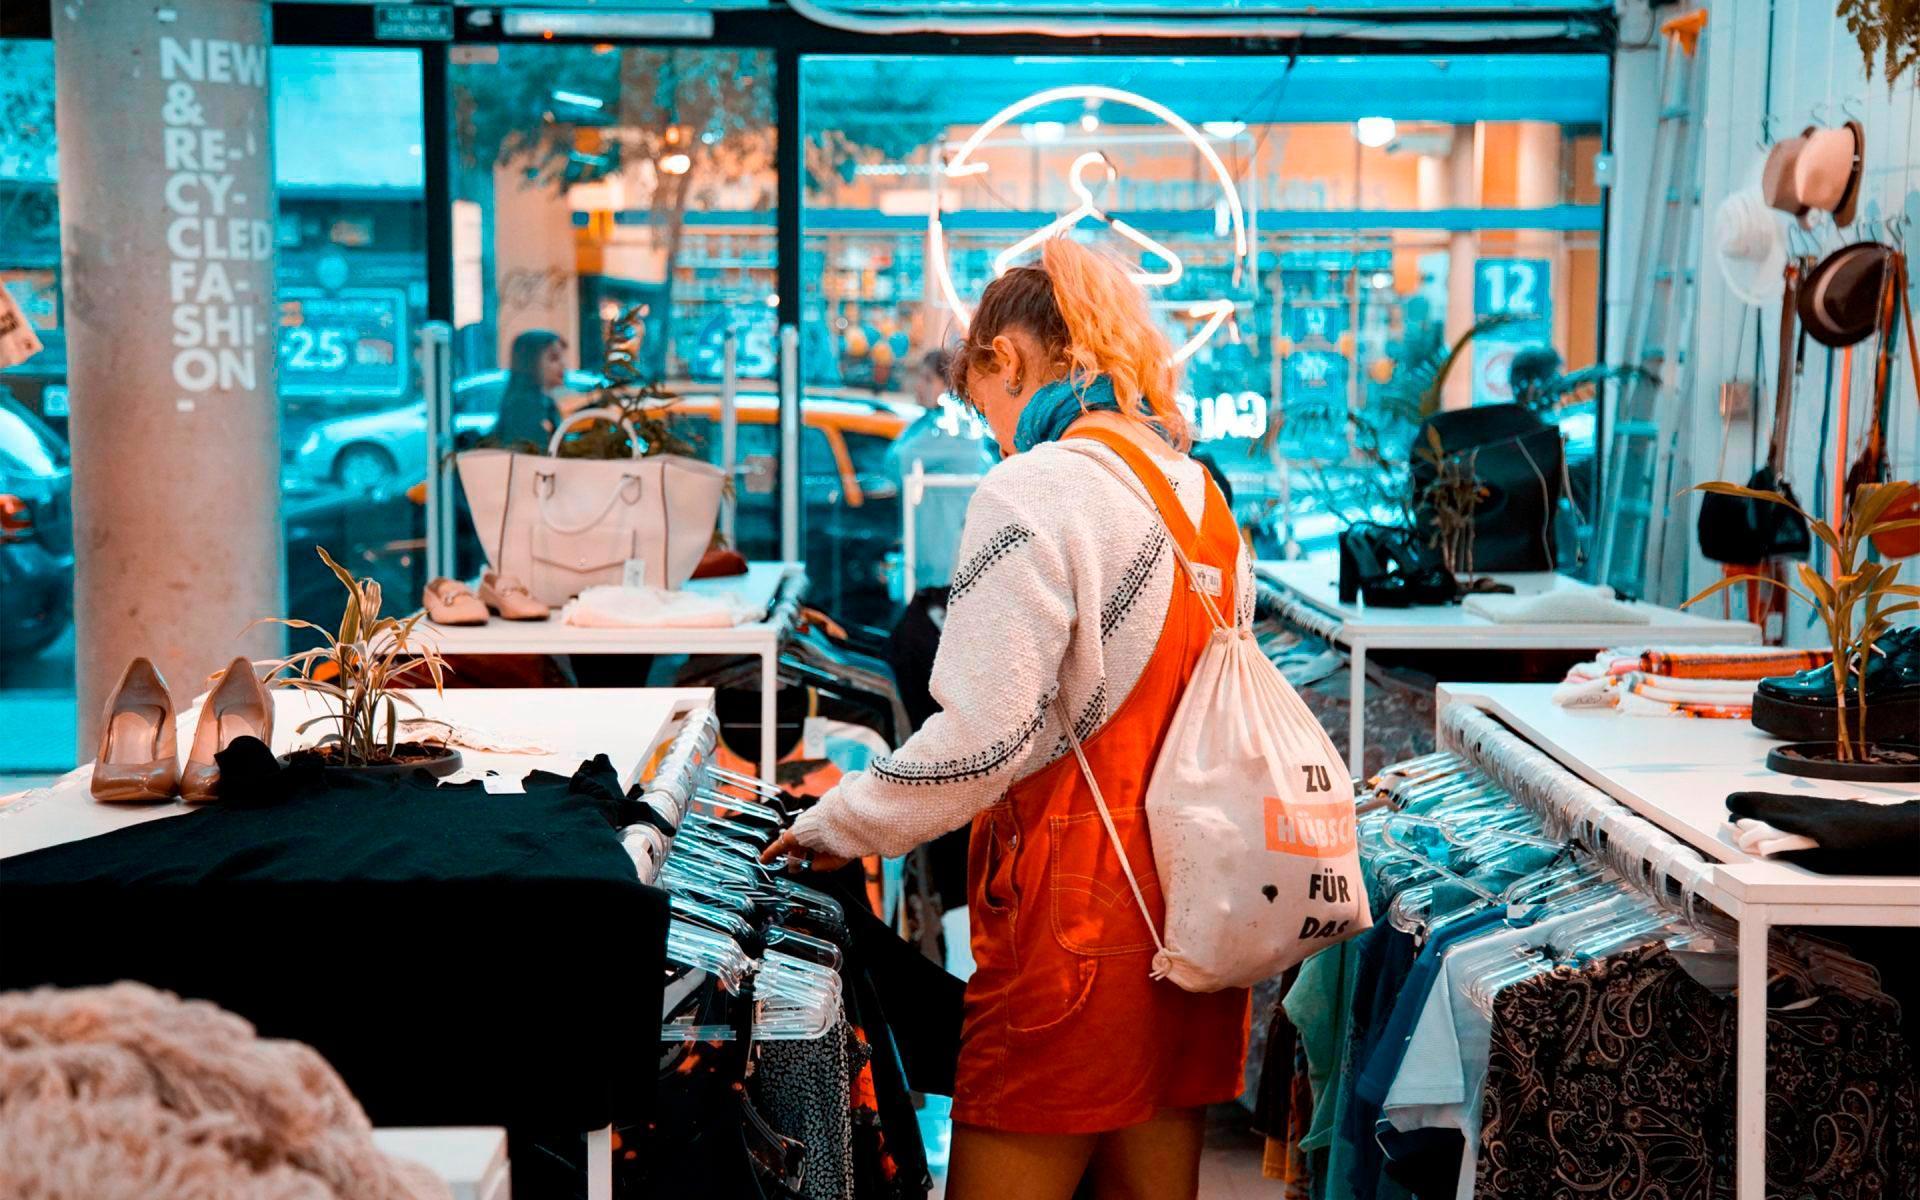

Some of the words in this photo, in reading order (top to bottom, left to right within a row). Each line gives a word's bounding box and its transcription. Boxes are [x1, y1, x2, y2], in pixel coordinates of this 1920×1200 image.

[159, 36, 267, 88] NEW
[161, 80, 206, 127] &
[164, 126, 243, 173] RE-
[164, 171, 247, 216] CY-
[167, 216, 273, 262] CLED
[169, 260, 250, 304] FA-
[1482, 264, 1537, 311] 12
[171, 303, 267, 349] SHI-
[172, 347, 257, 393] ON
[1301, 764, 1332, 794] ZU
[1308, 867, 1352, 904] FÜR
